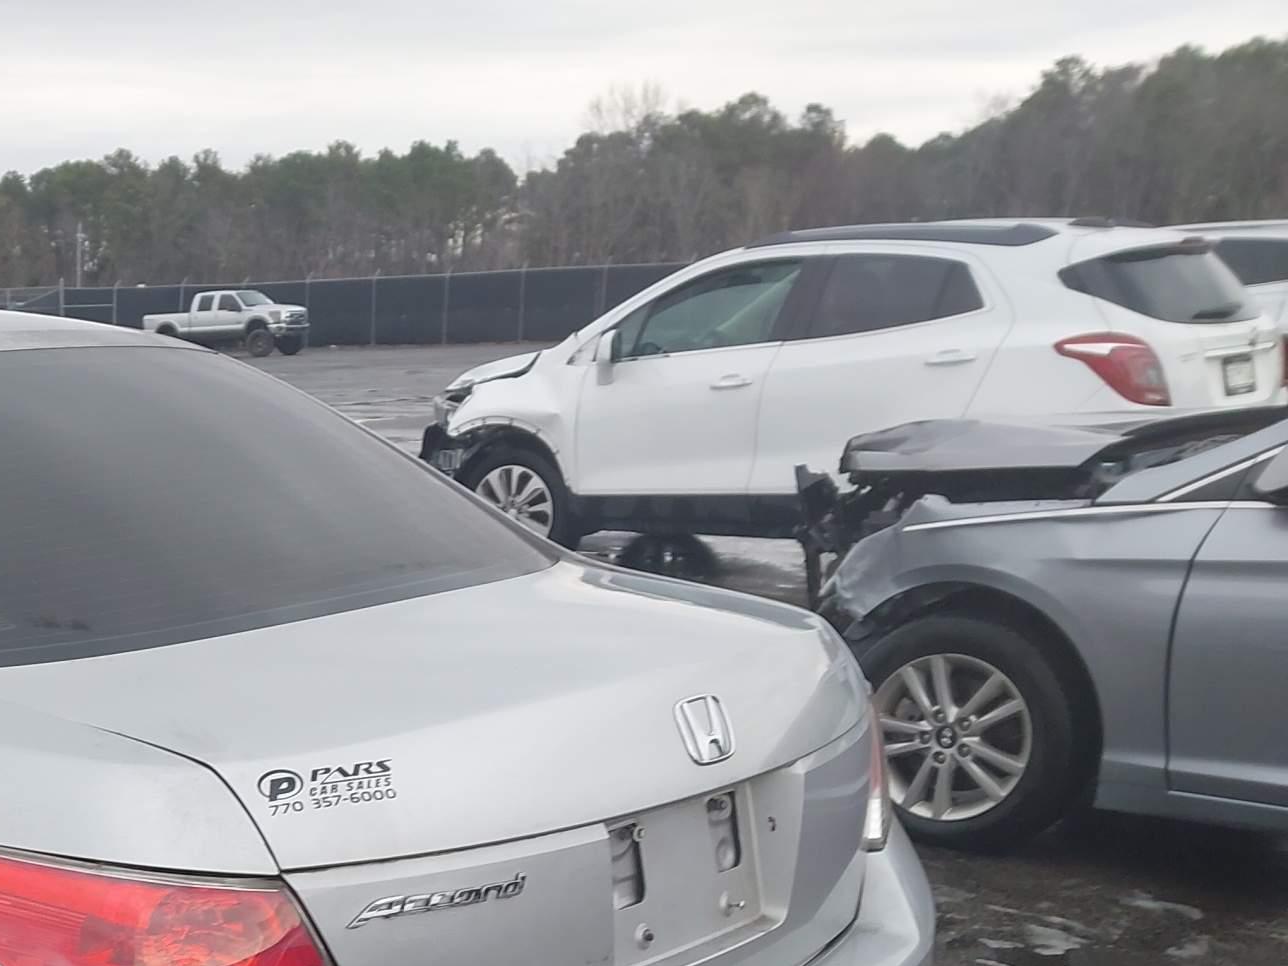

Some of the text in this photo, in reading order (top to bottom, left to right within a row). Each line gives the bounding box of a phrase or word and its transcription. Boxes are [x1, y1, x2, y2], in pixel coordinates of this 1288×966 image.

[310, 759, 393, 784] PARS
[309, 776, 392, 798] CAR SALES
[268, 788, 397, 816] 770 357-6000
[345, 872, 528, 930] Accord
